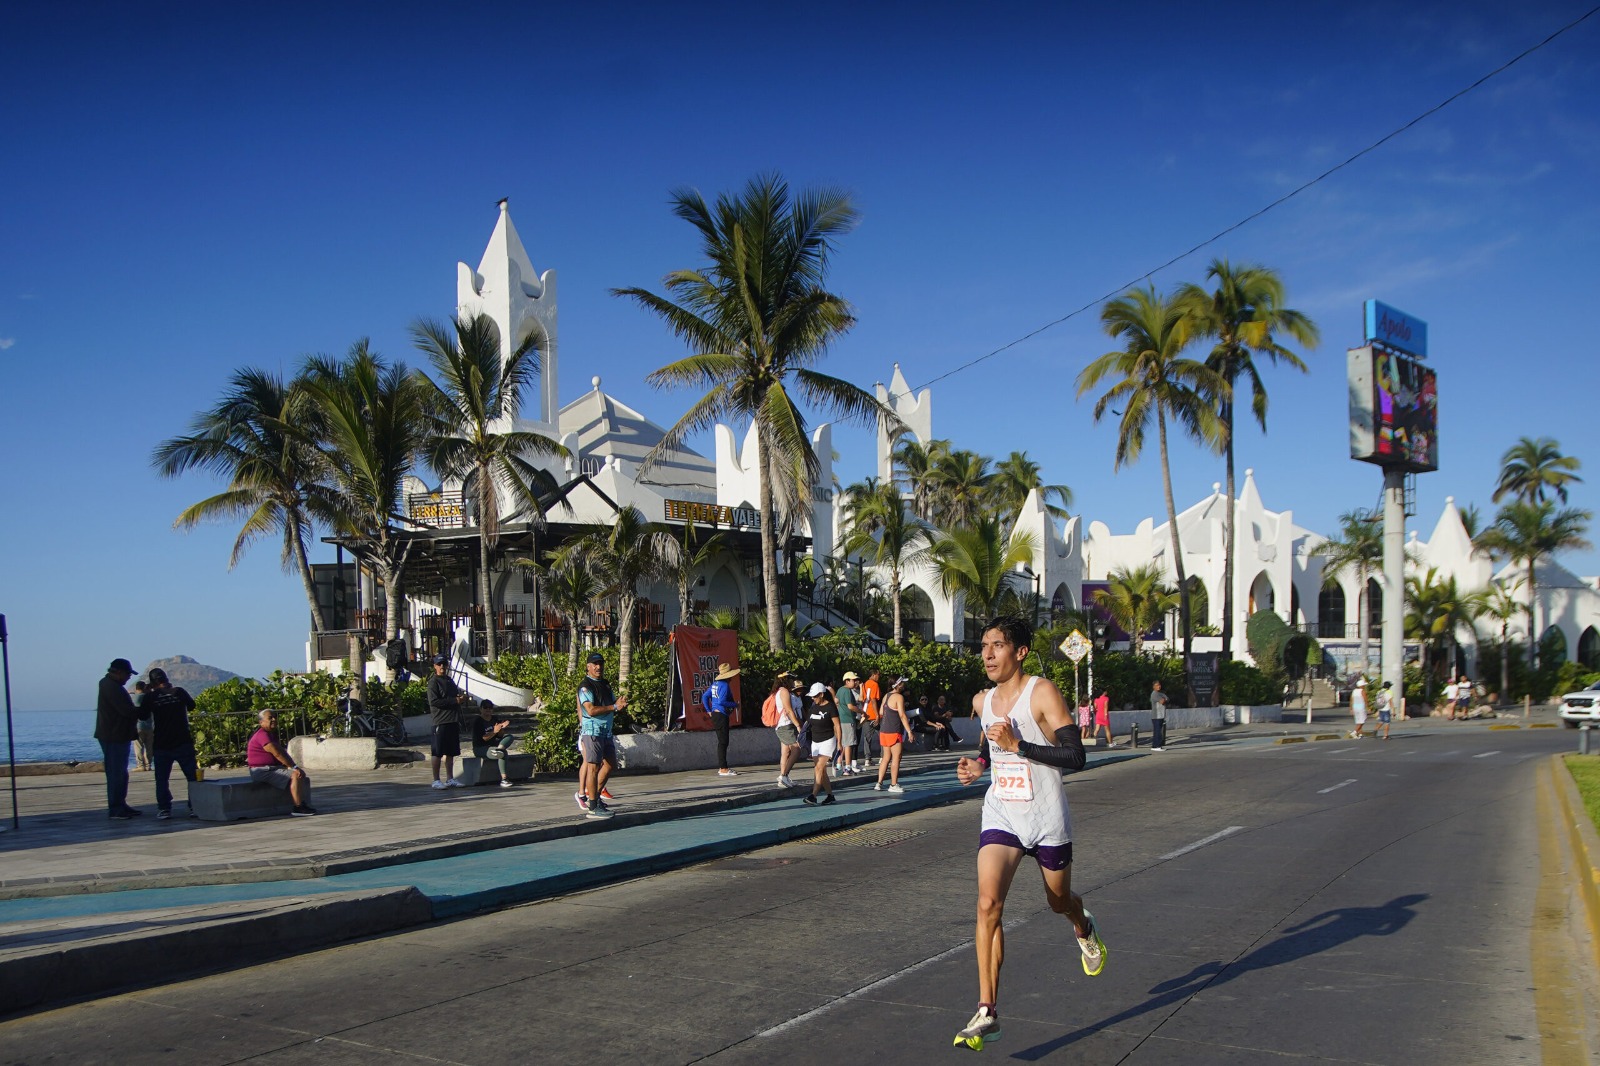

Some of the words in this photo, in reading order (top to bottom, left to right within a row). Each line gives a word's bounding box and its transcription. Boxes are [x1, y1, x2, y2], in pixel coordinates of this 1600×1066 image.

[412, 505, 460, 518] TERRAZA
[667, 500, 733, 524] TERRAZA
[699, 655, 719, 671] HOY
[999, 777, 1025, 788] 972
